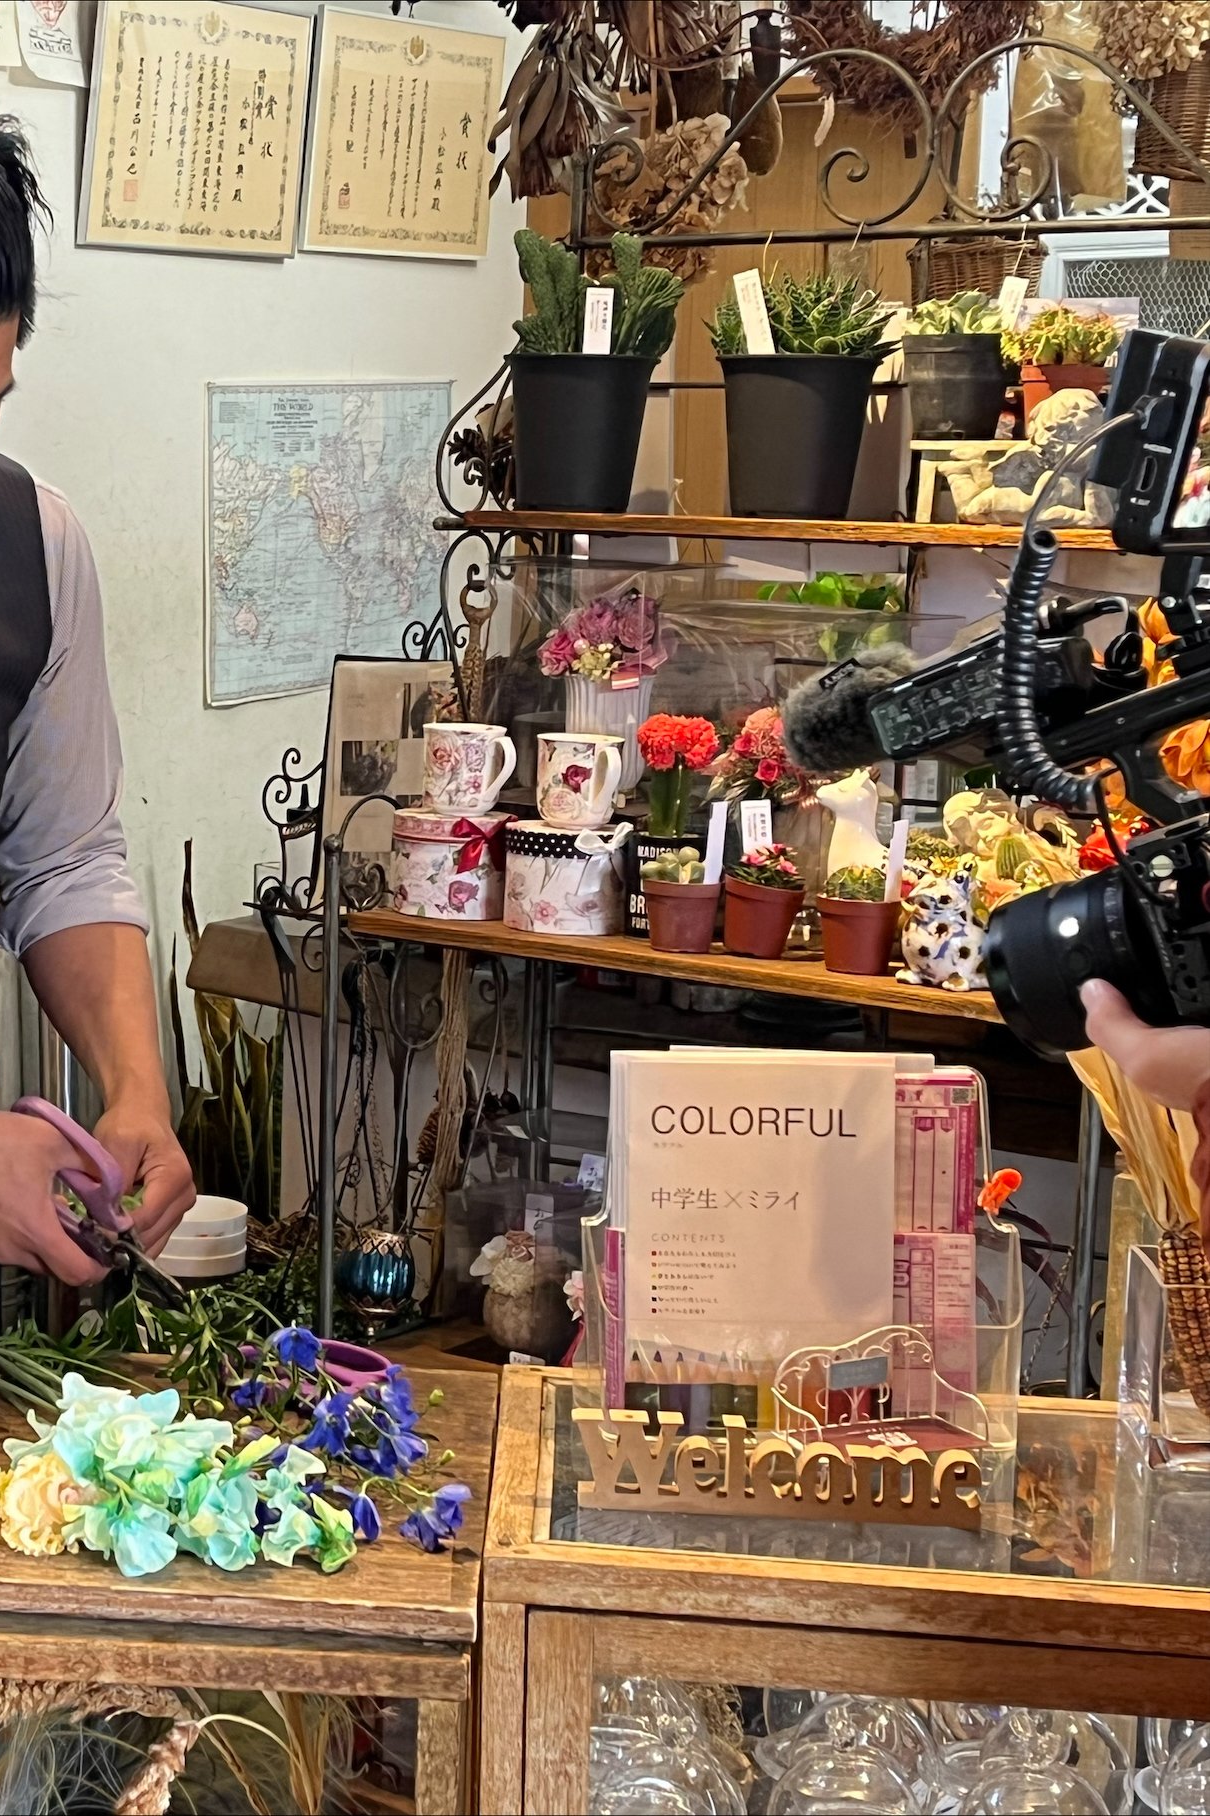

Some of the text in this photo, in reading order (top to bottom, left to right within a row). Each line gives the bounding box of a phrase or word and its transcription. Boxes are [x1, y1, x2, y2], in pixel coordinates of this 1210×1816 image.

[651, 1105, 857, 1137] COLORFUL
[651, 1233, 725, 1243] CONTENTS
[571, 1408, 982, 1509] Welcome
